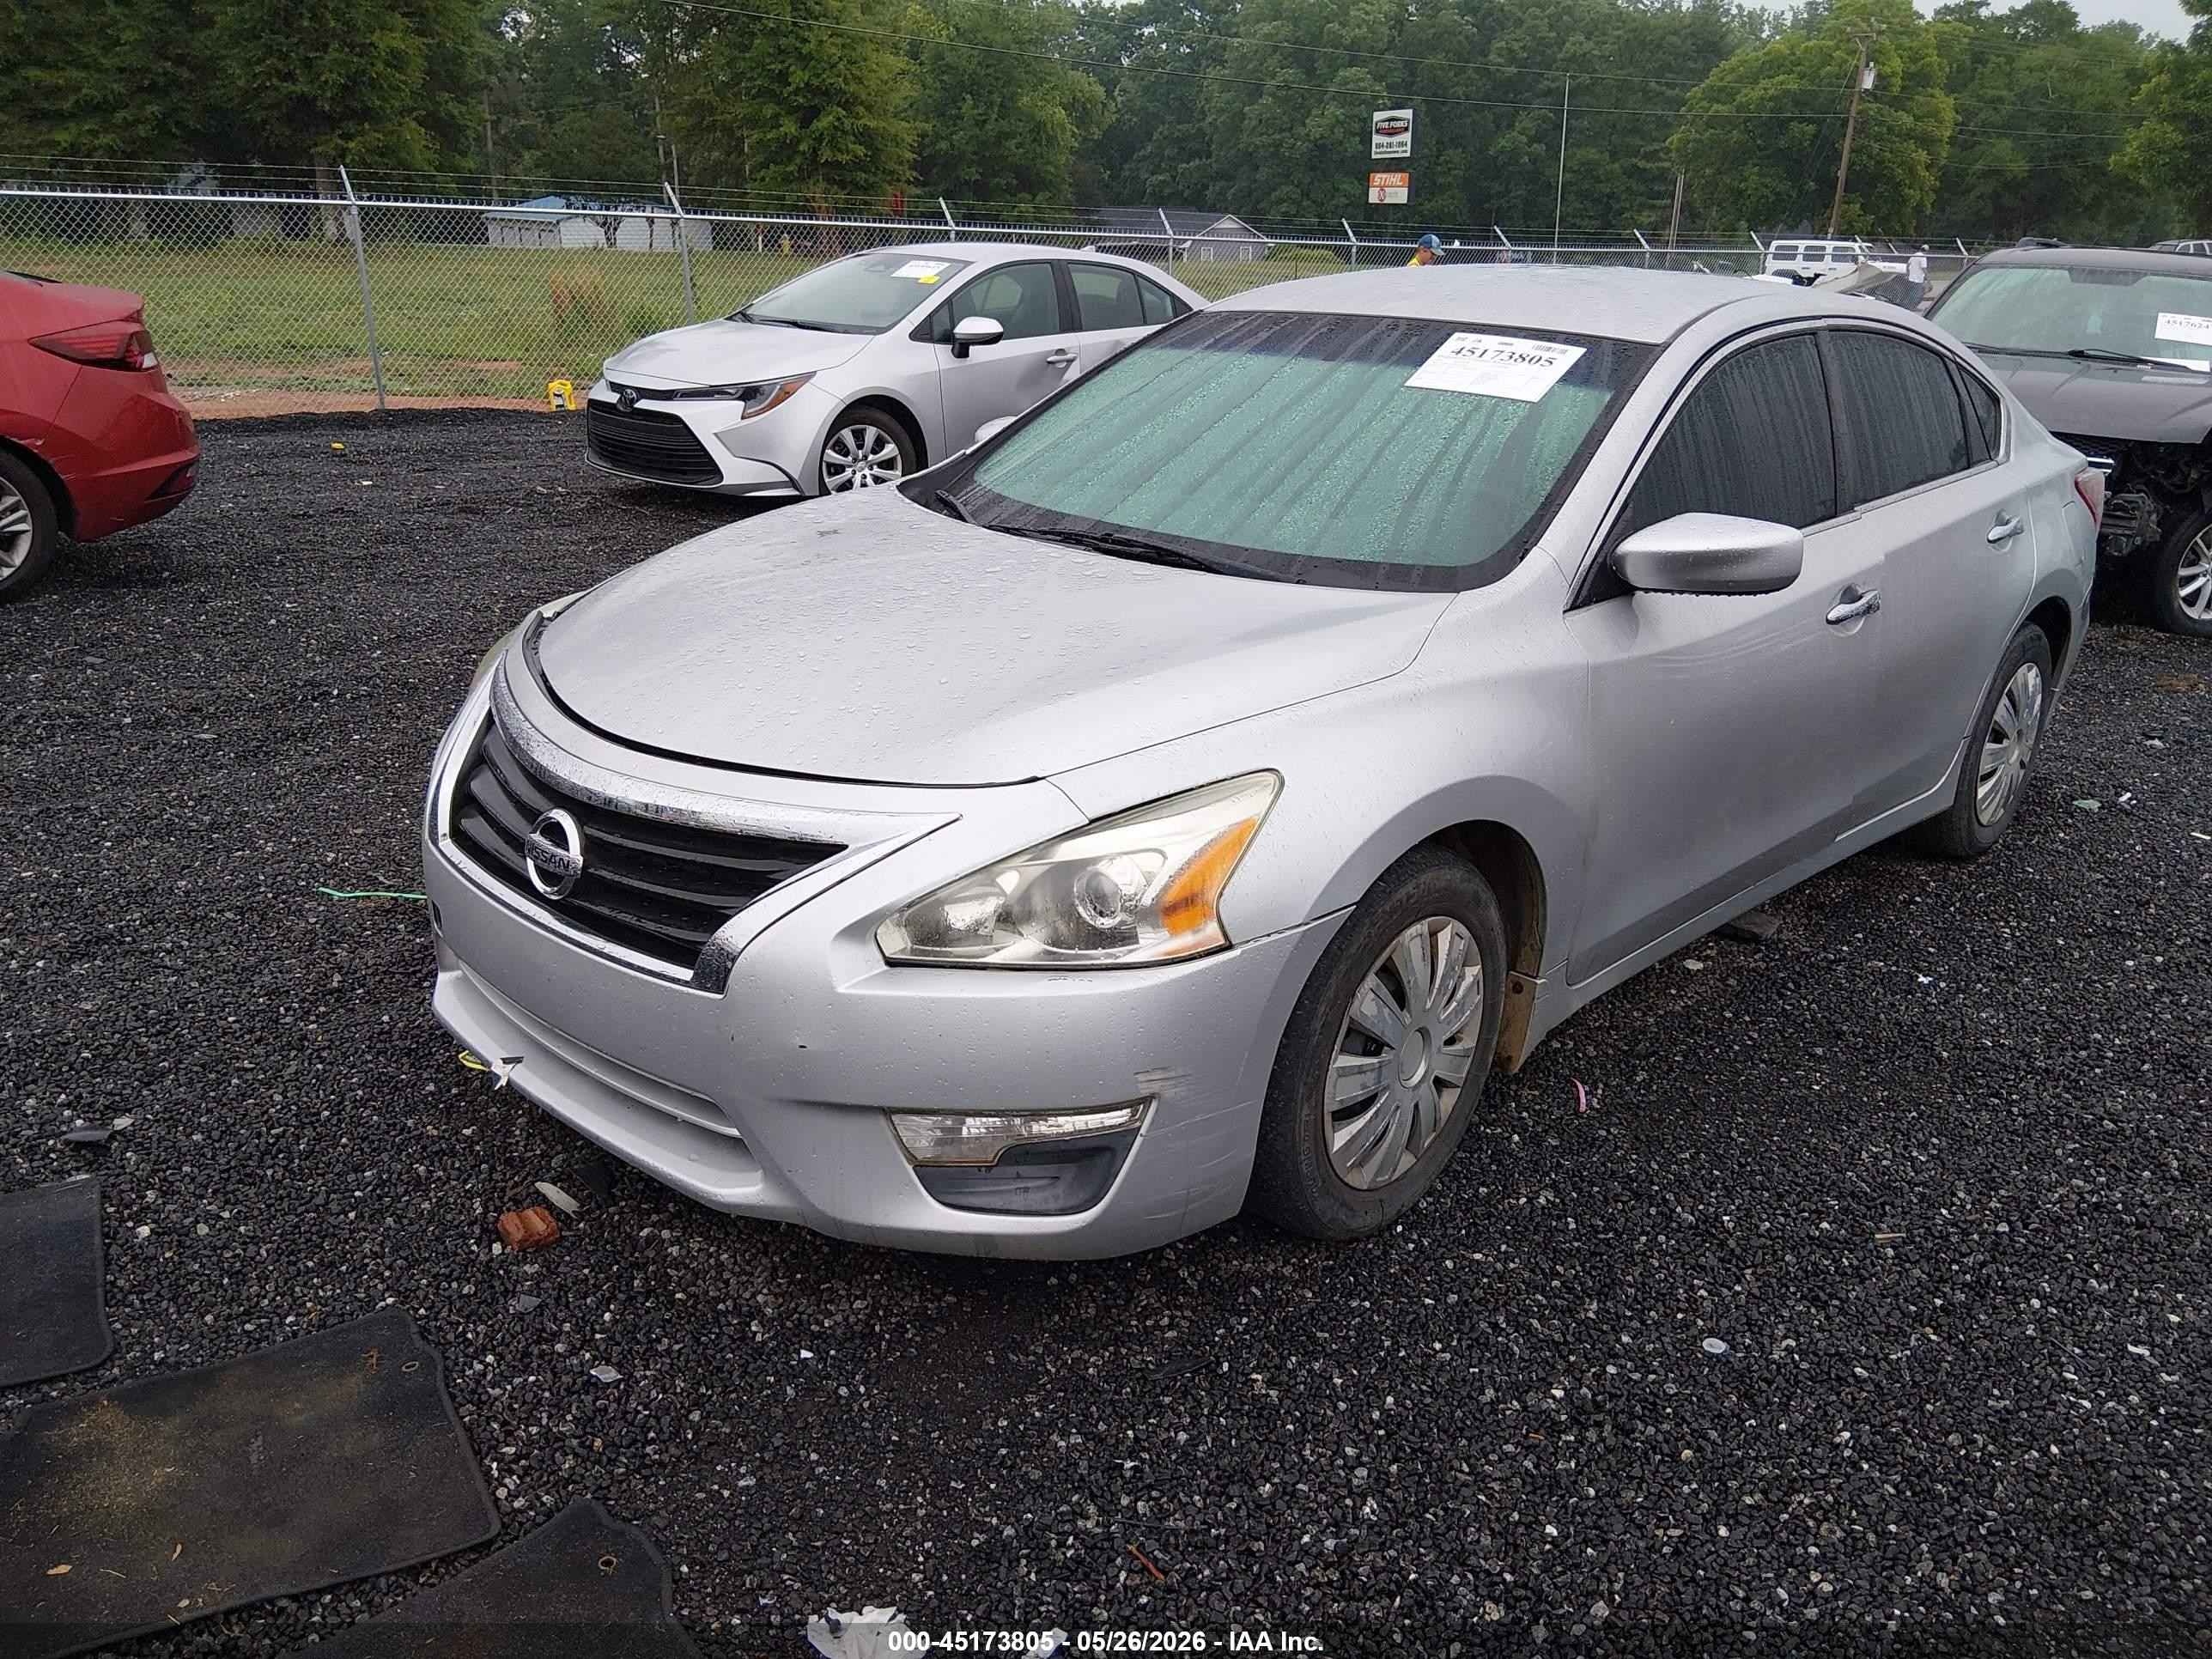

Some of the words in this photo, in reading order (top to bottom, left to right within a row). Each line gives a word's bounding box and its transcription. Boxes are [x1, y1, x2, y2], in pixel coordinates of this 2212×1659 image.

[1373, 174, 1403, 185] STIHL
[1449, 345, 1559, 368] 45173805
[526, 839, 570, 872] NISSAN
